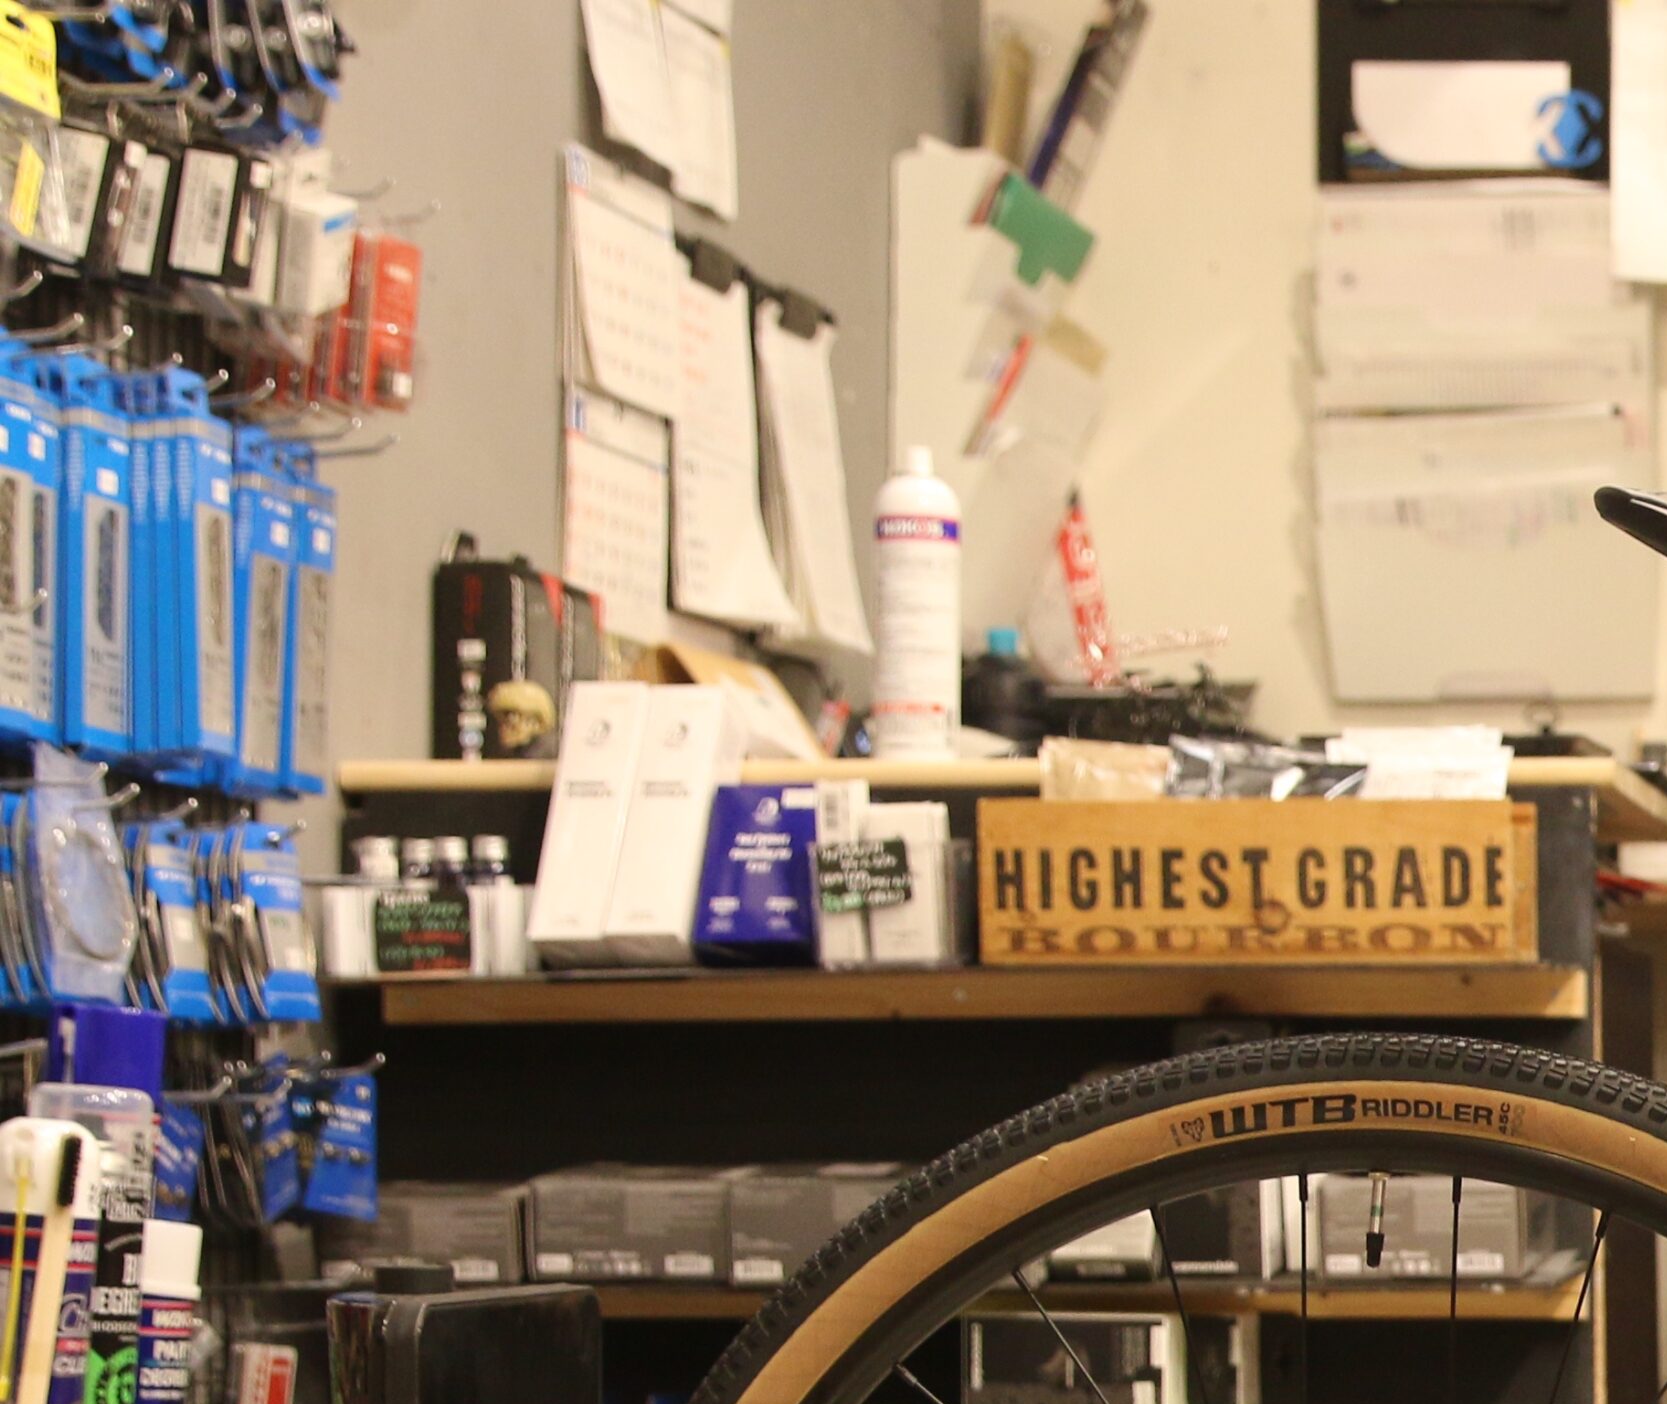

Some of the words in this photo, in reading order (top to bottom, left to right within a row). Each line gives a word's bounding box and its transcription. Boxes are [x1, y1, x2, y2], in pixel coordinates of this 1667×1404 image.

[995, 847, 1269, 911] HIGHEST
[1297, 846, 1505, 910] GRADE
[1001, 922, 1508, 955] BOURBON
[1209, 1094, 1357, 1139] WTB
[1361, 1098, 1494, 1127] RIDDLER
